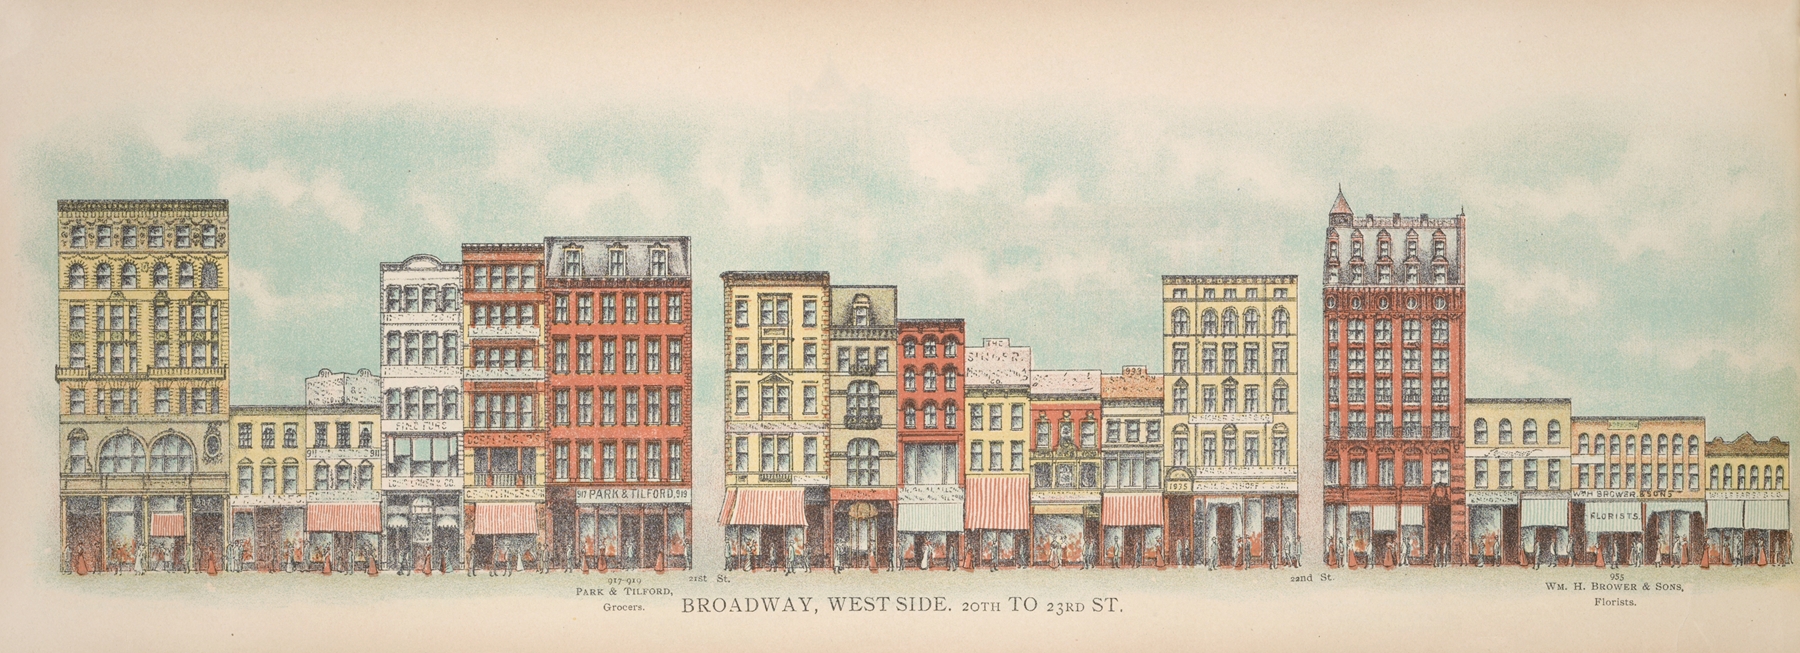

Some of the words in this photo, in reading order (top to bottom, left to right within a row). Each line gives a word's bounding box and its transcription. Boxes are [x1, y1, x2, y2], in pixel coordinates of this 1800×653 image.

[589, 489, 619, 499] PARK
[621, 489, 629, 499] &
[676, 490, 688, 498] 919
[607, 577, 642, 585] 917-919
[688, 574, 707, 583] 21st
[716, 573, 731, 583] St.
[1290, 573, 1313, 582] 22nd
[1320, 573, 1335, 582] St.
[1610, 573, 1625, 581] 955
[1573, 582, 1586, 591] H.
[1591, 582, 1637, 591] BROWER
[1642, 582, 1651, 591] &
[576, 587, 605, 596] PARK
[609, 587, 618, 596] &
[623, 587, 674, 597] TILFORD,
[603, 602, 645, 612] Grocers.
[681, 596, 819, 615] BROADWAY,
[827, 596, 891, 613] WEST
[895, 596, 952, 613] SIDE.
[961, 601, 1001, 613] 20TH
[1007, 596, 1038, 612] TO
[1046, 602, 1085, 617] 23RD
[1091, 596, 1123, 613] ST.
[1594, 597, 1637, 607] Florists.
